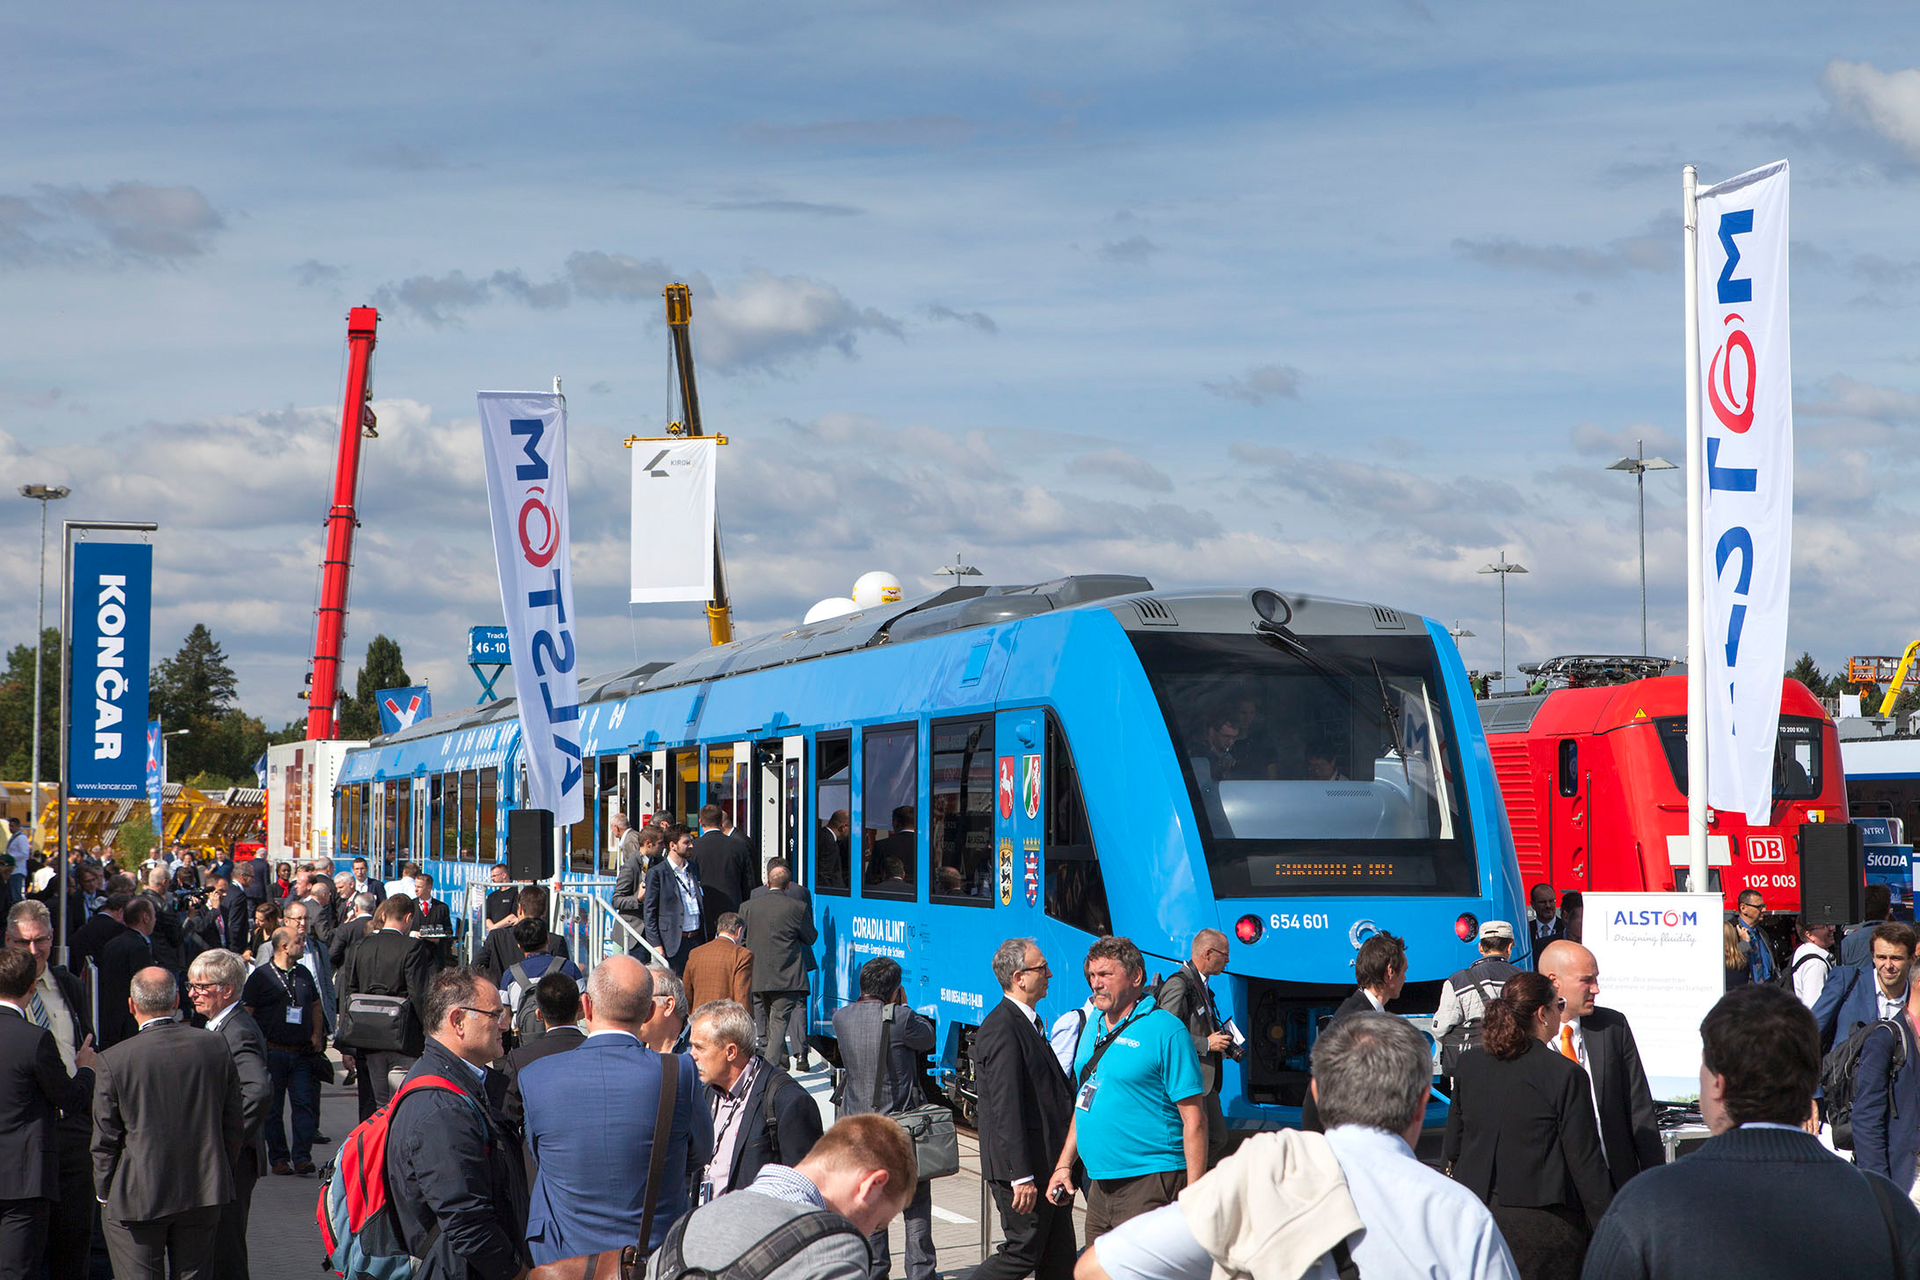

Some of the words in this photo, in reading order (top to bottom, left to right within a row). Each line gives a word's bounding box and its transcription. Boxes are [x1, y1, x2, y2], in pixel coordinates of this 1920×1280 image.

[94, 574, 129, 760] KONČAR
[76, 782, 137, 790] www.koncar.com
[1863, 827, 1885, 835] NTRY
[1751, 840, 1781, 859] DB
[1867, 852, 1908, 867] ŠKODA
[1743, 875, 1768, 888] 102
[1772, 875, 1796, 888] 003
[1270, 914, 1300, 929] 654
[1303, 914, 1328, 929] 601
[1614, 909, 1697, 927] ALSTOM
[852, 916, 884, 941] CORADIA
[1614, 932, 1658, 946] Designing
[1659, 932, 1697, 947] fluidity
